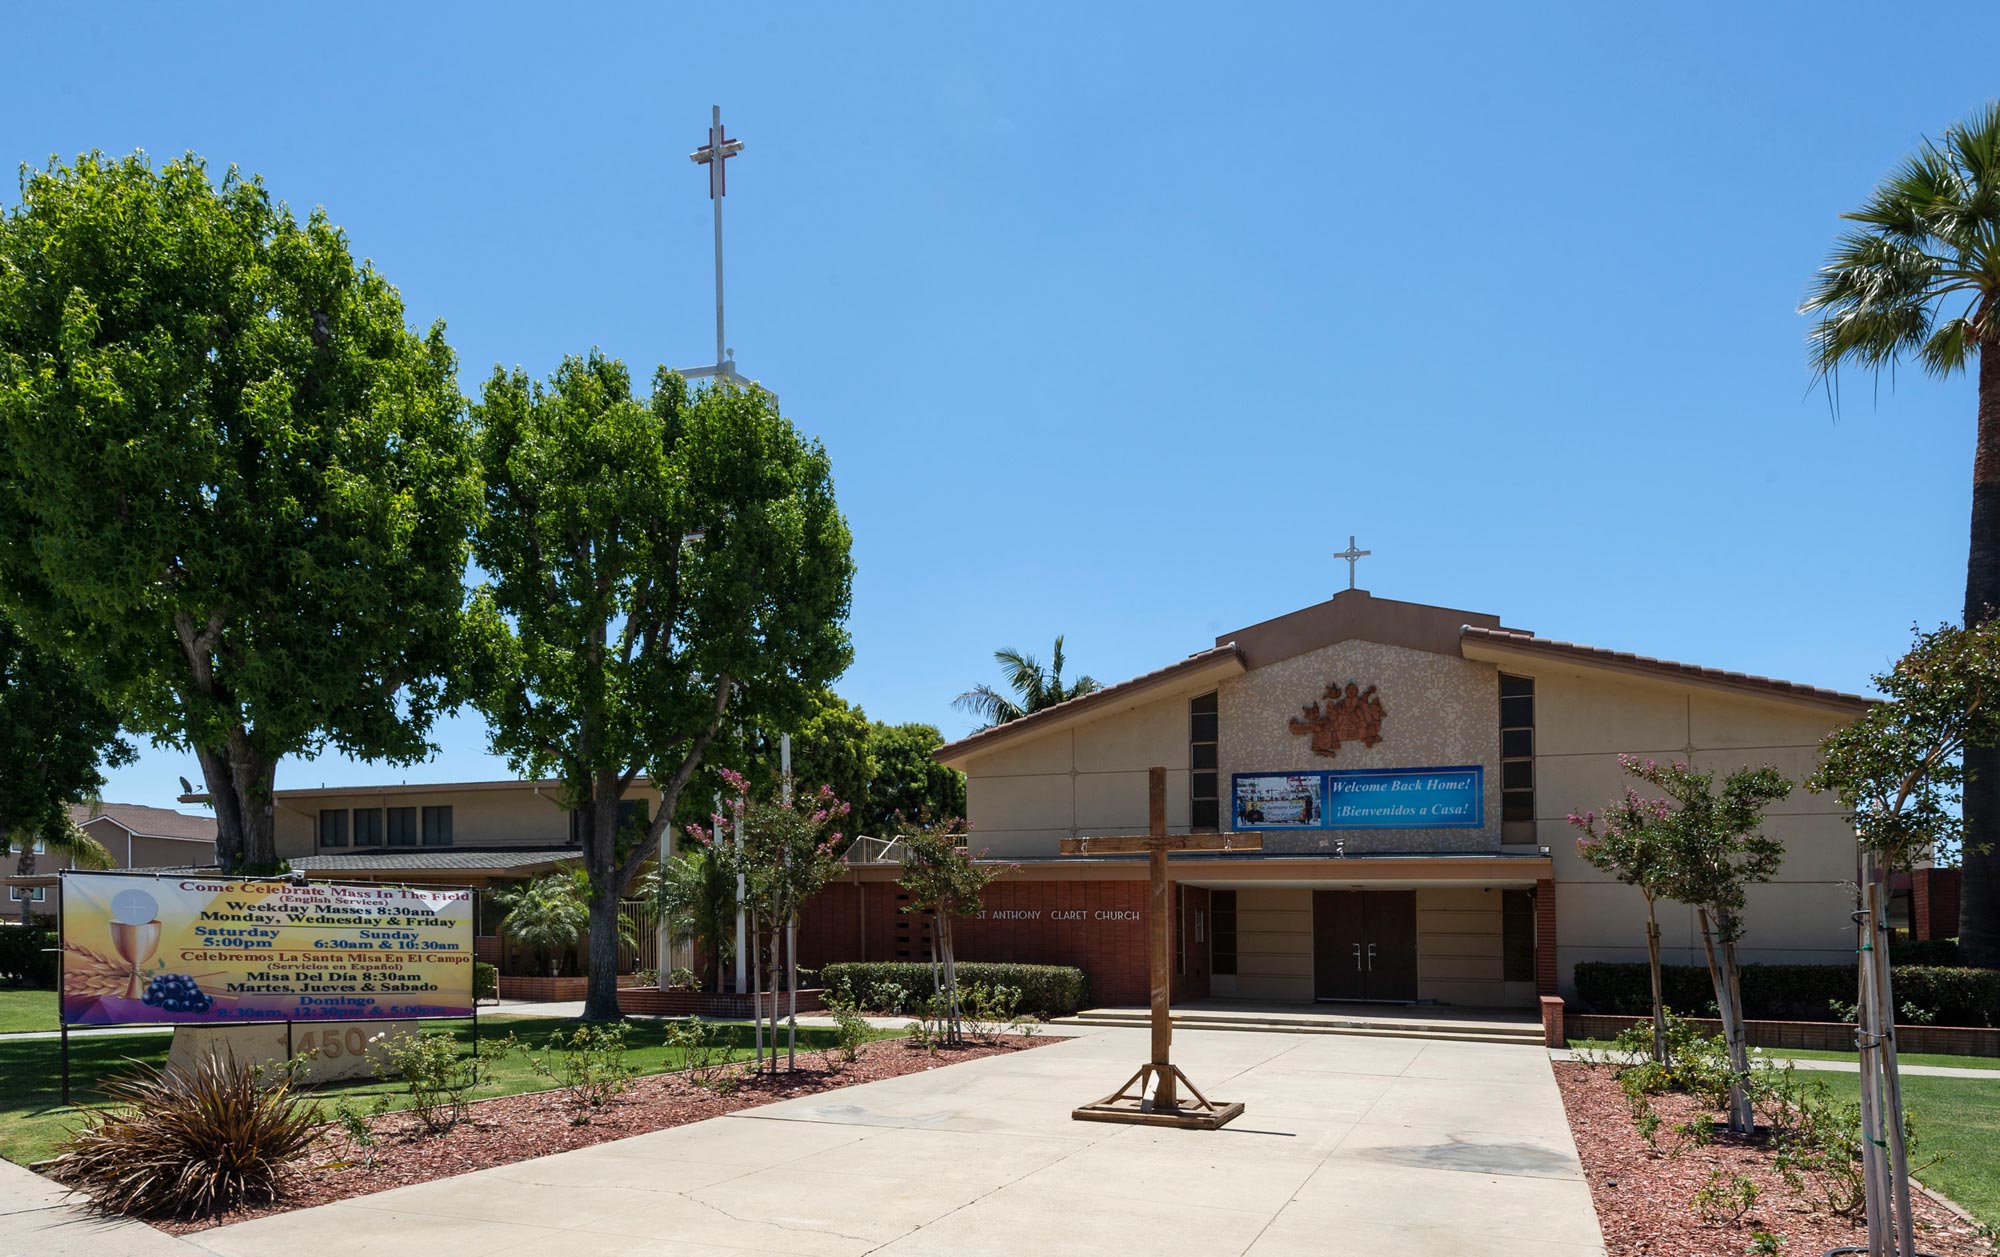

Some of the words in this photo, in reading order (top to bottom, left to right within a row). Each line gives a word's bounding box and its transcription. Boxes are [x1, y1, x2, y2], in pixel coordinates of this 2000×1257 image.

[1333, 782, 1387, 792] Welcome
[1391, 780, 1422, 791] Back
[1426, 778, 1470, 790] Home!
[1337, 805, 1415, 816] ¡Bienvenidos
[1431, 804, 1468, 814] Casa!
[180, 882, 234, 892] Come
[240, 884, 325, 895] Celebrate
[332, 888, 371, 898] Mass
[377, 890, 393, 898] In
[398, 890, 426, 900] The
[280, 896, 330, 904] (English
[335, 898, 388, 906] Services)
[226, 902, 309, 914] Weekday
[314, 905, 372, 914] Masses
[377, 907, 434, 916] 8:30am
[200, 912, 280, 924] Monday,
[286, 914, 381, 926] Wednesday
[406, 918, 456, 928] Friday
[977, 911, 987, 919] ST
[993, 911, 1041, 919] ANTHONY
[1051, 911, 1087, 919] CLARET
[1095, 911, 1139, 920] CHURCH
[195, 926, 280, 939] Saturday
[360, 930, 419, 941] Sunday
[204, 938, 272, 949] 5:00pm
[314, 939, 373, 949] 6:30am
[399, 941, 459, 950] 10:30am
[181, 952, 274, 961] Celebremos
[279, 953, 298, 961] La
[302, 953, 343, 962] Santa
[348, 954, 381, 962] Misa
[386, 954, 403, 962] En
[408, 954, 421, 962] El
[426, 954, 469, 964] Campo
[247, 972, 289, 981] Misa
[296, 973, 322, 981] Del
[329, 973, 357, 981] Día
[363, 973, 420, 981] 8:30am
[227, 983, 295, 993] Martes,
[300, 984, 356, 992] Jueves
[361, 984, 375, 992] &
[381, 983, 438, 991] Sabado
[300, 996, 375, 1006] Domingo
[295, 1007, 363, 1017] 12:30pm
[391, 1006, 446, 1015] 5:00pm
